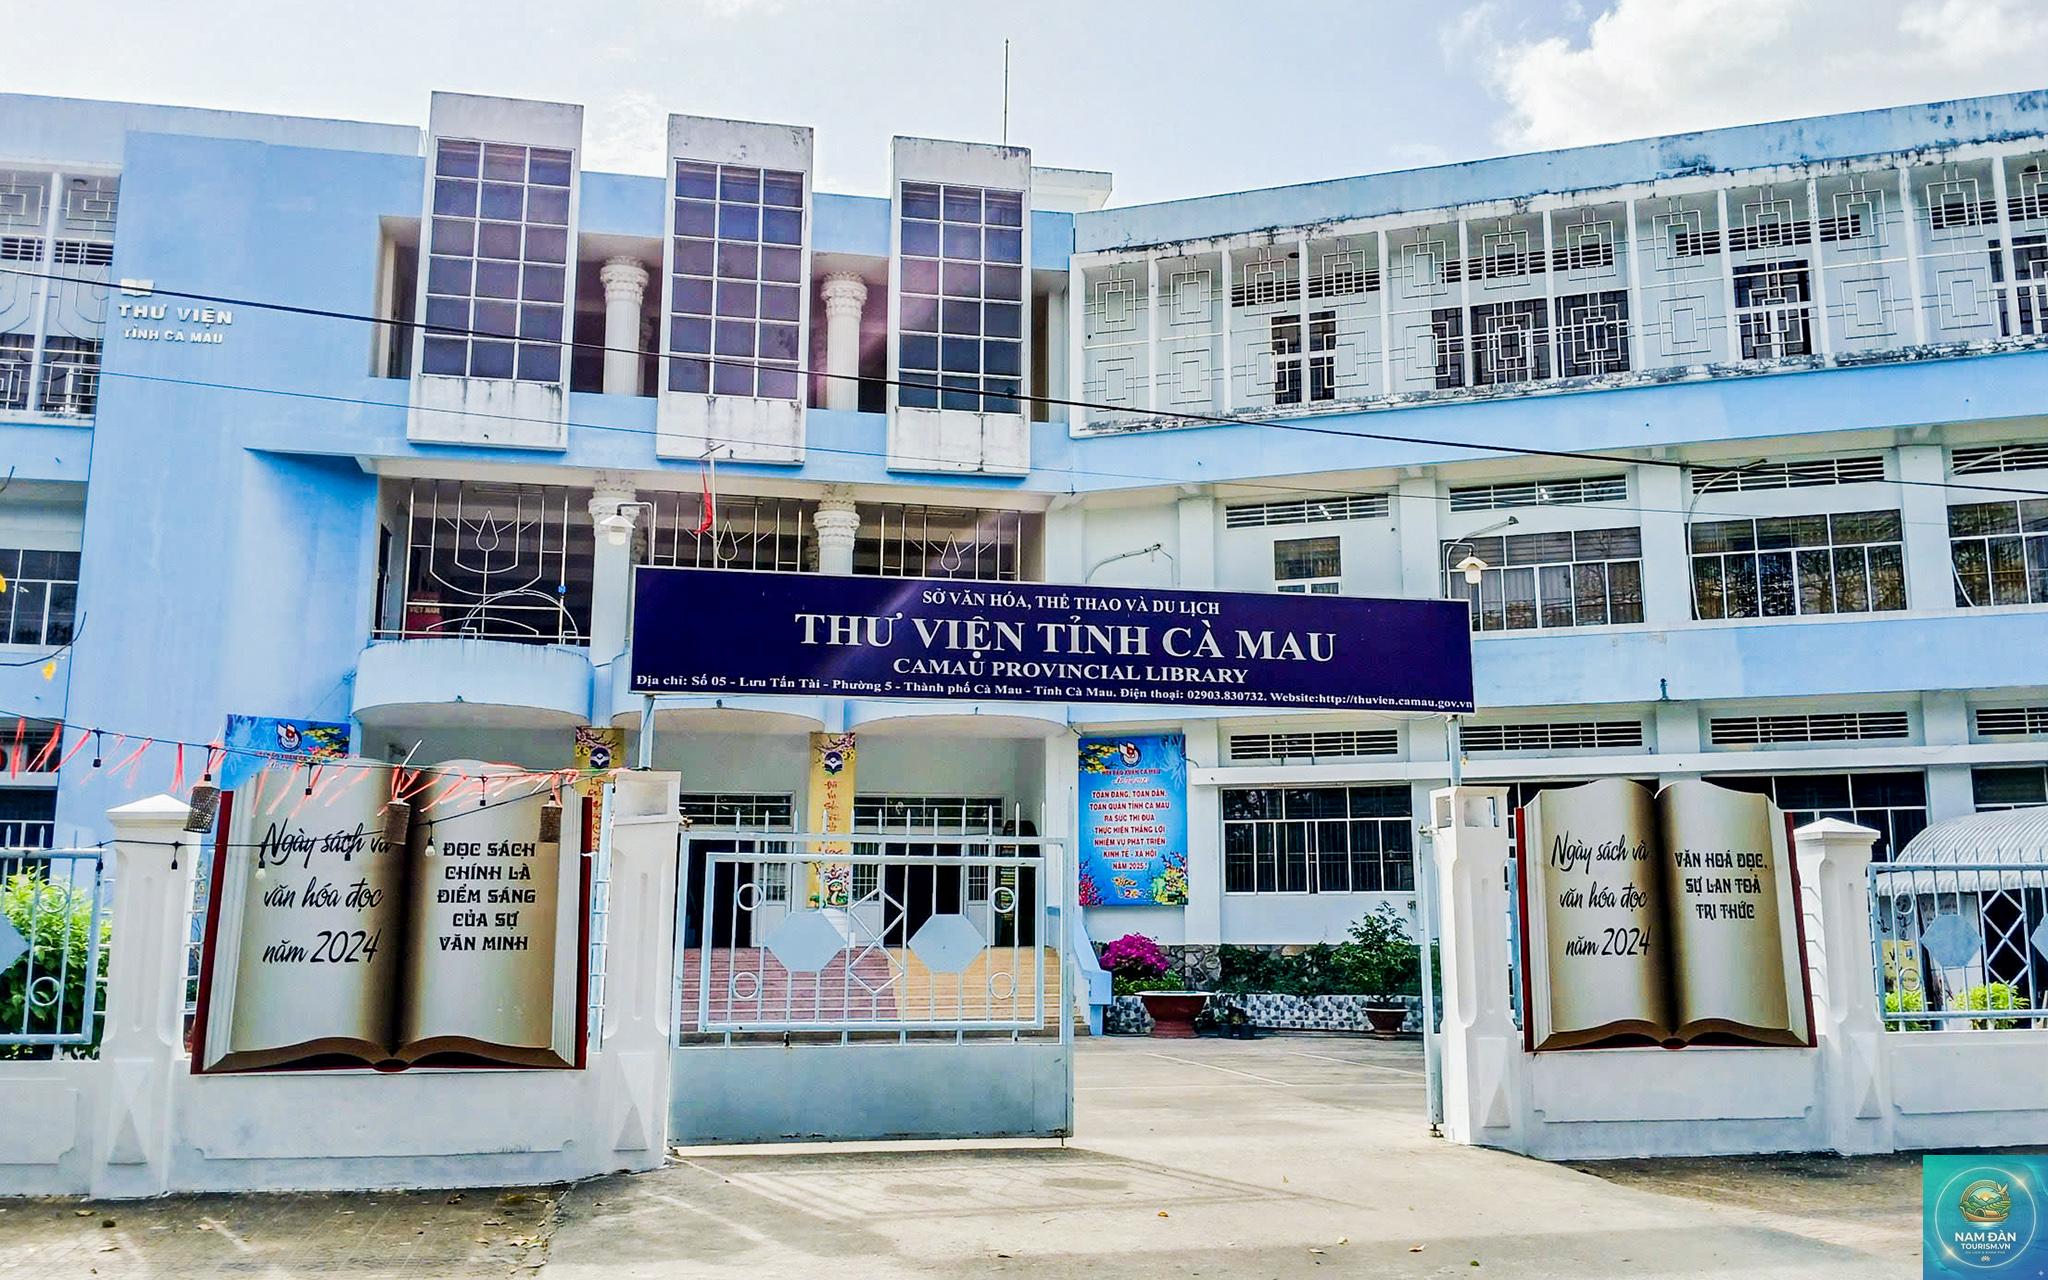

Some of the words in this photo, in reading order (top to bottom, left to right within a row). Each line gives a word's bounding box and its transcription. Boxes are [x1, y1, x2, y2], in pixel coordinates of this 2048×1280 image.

[118, 303, 168, 321] THƯ
[177, 306, 232, 329] VIỆN
[190, 331, 224, 344] MAU
[922, 588, 946, 604] SỞ
[949, 590, 985, 606] VĂN
[990, 591, 1032, 610] HÓA,
[1074, 597, 1122, 611] THAO
[1125, 596, 1149, 612] VÀ
[1153, 600, 1175, 613] DU
[1179, 601, 1220, 616] LỊCH
[795, 612, 903, 647] THƯ
[911, 615, 1026, 659] VIỆN
[1037, 615, 1151, 655] TỈNH
[1162, 619, 1225, 658] CÀ
[1235, 629, 1336, 662] MAU
[893, 658, 985, 676] CAMAU
[991, 661, 1141, 681] PROVINCIAL
[1145, 665, 1249, 684] LIBRARY
[636, 675, 659, 687] Địa
[663, 675, 687, 686] chỉ:
[691, 674, 708, 686] Số
[711, 676, 727, 686] 05
[739, 677, 766, 687] Lưu
[770, 675, 795, 688] Tấn
[799, 678, 820, 689] Tài
[832, 679, 881, 692] Phường
[884, 682, 893, 691] 5
[904, 681, 944, 692] Thành
[947, 681, 971, 694] phố
[974, 683, 992, 694] Cà
[995, 685, 1022, 695] Mau
[1034, 685, 1062, 696] Tỉnh
[1065, 686, 1082, 697] Cà
[1086, 687, 1117, 698] Mau.
[1120, 687, 1147, 699] Điện
[1150, 689, 1184, 700] thoại:
[1187, 690, 1267, 702] 02903.830732.
[261, 817, 317, 868] Ngày
[320, 823, 365, 853] sách
[443, 842, 481, 859] ĐỌC
[487, 839, 536, 857] SÁCH
[1103, 850, 1119, 858] KINH
[1551, 830, 1593, 875] Ngày
[1596, 834, 1629, 861] sách
[1632, 839, 1650, 861] và
[445, 863, 502, 880] CHÍNH
[508, 863, 531, 880] LÀ
[1674, 849, 1702, 868] VĂN
[264, 884, 296, 908] văn
[301, 876, 342, 908] hóa
[345, 877, 384, 912] đọc
[437, 883, 481, 903] ĐIỂM
[487, 886, 536, 903] SÁNG
[1560, 888, 1584, 909] văn
[1588, 881, 1617, 909] hóa
[1620, 881, 1648, 912] đọc
[1685, 876, 1703, 896] SỰ
[1706, 878, 1731, 893] LAN
[452, 909, 488, 927] CỦA
[495, 910, 520, 930] SỰ
[1696, 904, 1717, 920] TRI
[1720, 900, 1755, 919] THỨC
[262, 939, 308, 963] năm
[310, 928, 382, 963] 2024
[439, 933, 476, 951] VĂN
[482, 936, 528, 951] MINH
[1565, 936, 1600, 957] năm
[1601, 925, 1651, 956] 2024
